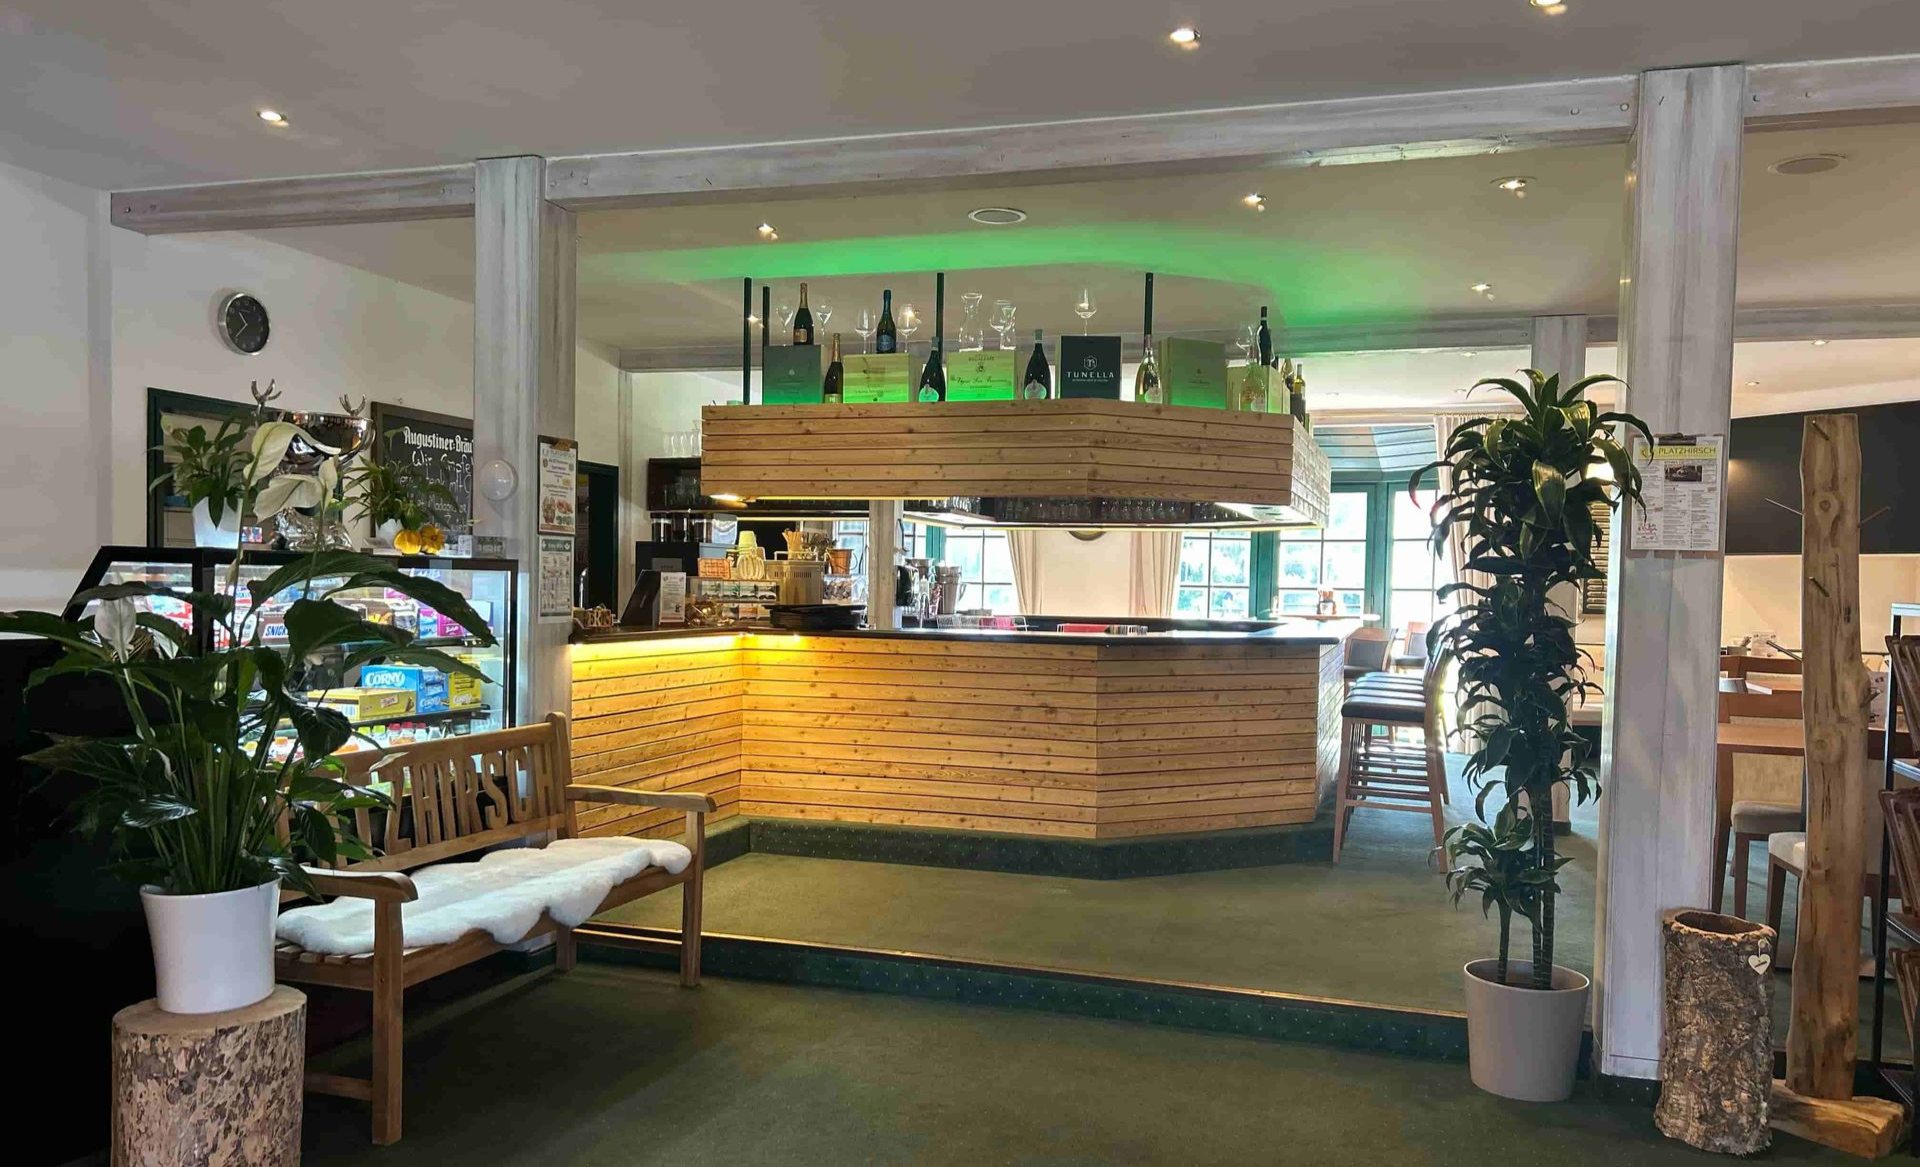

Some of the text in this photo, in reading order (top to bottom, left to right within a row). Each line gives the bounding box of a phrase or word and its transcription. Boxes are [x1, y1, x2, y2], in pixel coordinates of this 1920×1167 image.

[412, 450, 433, 467] Wir
[1658, 446, 1716, 455] PLATZHIRSCH
[365, 671, 406, 687] CORNY
